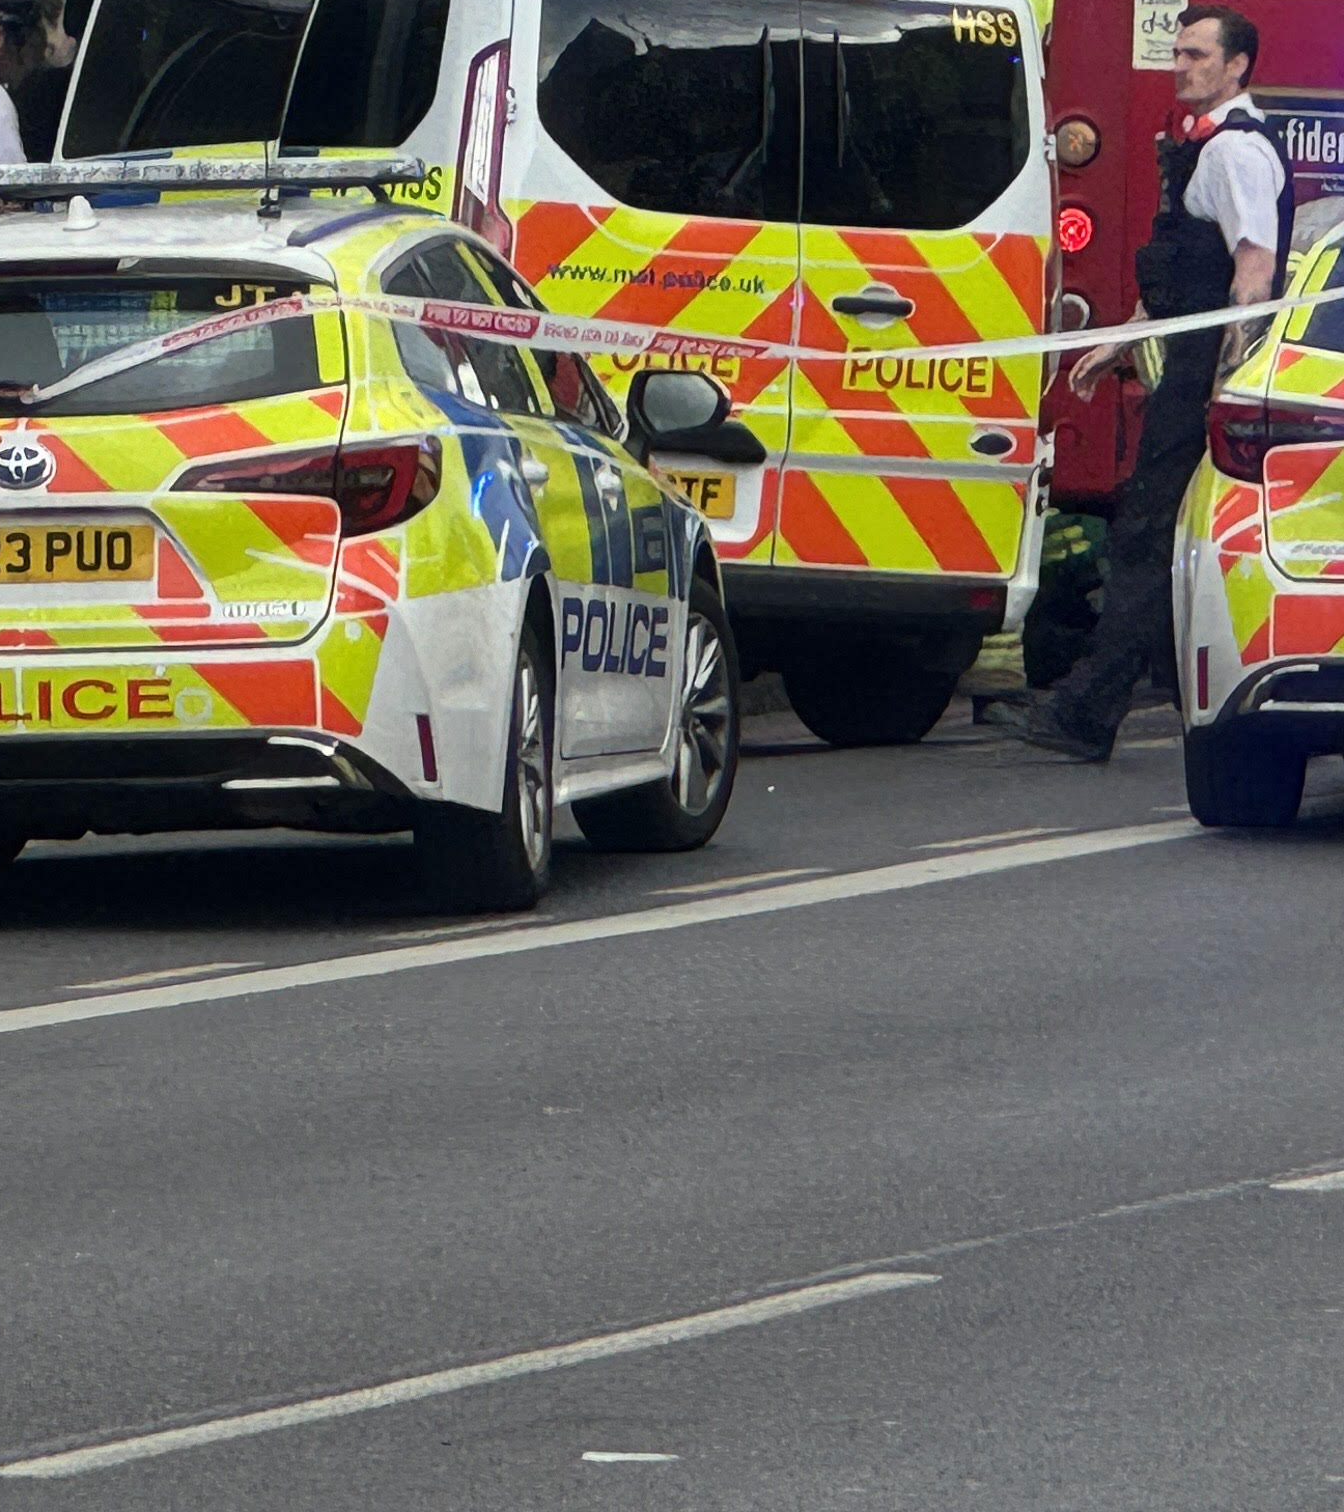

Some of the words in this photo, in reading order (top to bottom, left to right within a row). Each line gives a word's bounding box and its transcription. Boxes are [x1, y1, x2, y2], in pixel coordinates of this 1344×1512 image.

[952, 8, 1020, 48] HSS
[848, 349, 990, 394] POLICE
[666, 474, 722, 511] TF
[45, 529, 131, 573] PUO
[561, 597, 668, 678] POLICE
